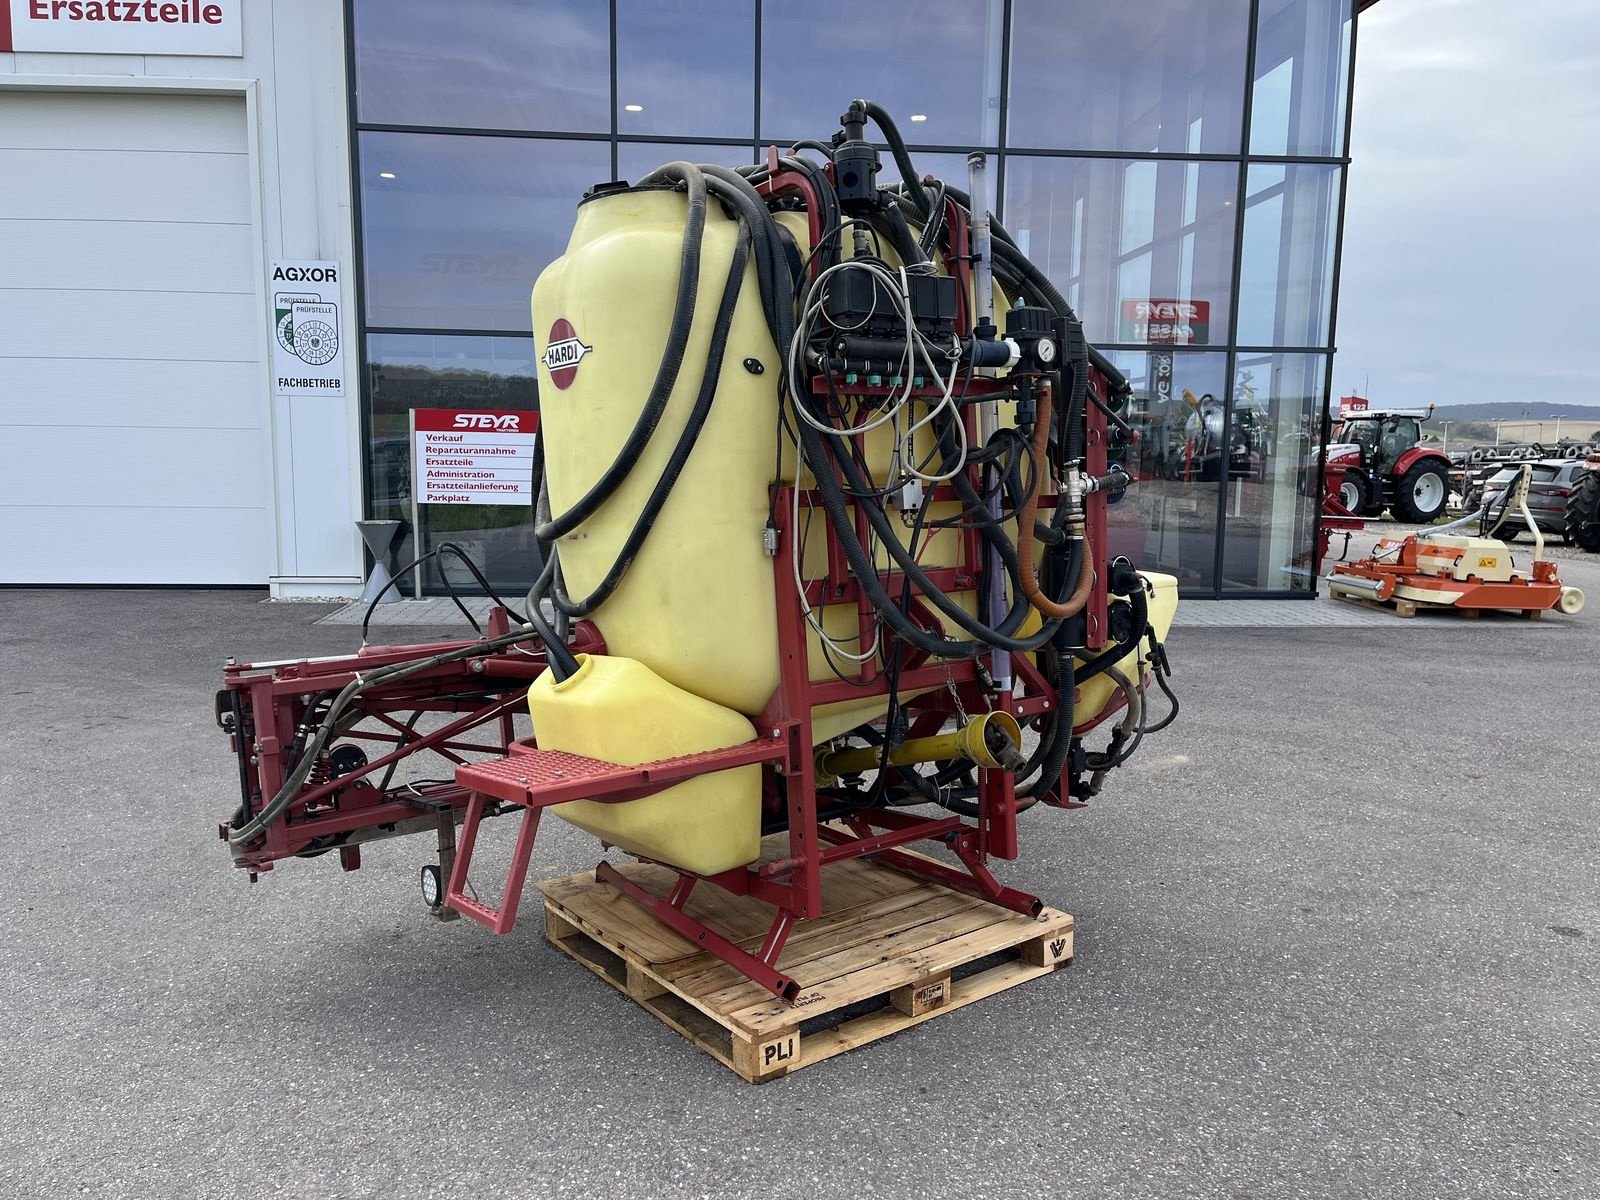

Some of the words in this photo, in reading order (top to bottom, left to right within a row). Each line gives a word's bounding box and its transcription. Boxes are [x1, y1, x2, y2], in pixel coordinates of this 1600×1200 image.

[29, 0, 223, 24] Ersatzteile
[273, 267, 337, 282] AGXOR
[548, 343, 578, 366] HARDI
[278, 377, 341, 389] FACHBETRIEB
[453, 413, 520, 429] STEYR
[426, 434, 464, 442] Verkauf
[425, 446, 517, 455] Reparaturannahme
[426, 458, 474, 467] Ersatzteile
[426, 470, 495, 479] Administration
[426, 482, 519, 492] Ersatzteilanlieferung
[427, 494, 470, 503] Parkplatz
[764, 1038, 794, 1066] PLI
